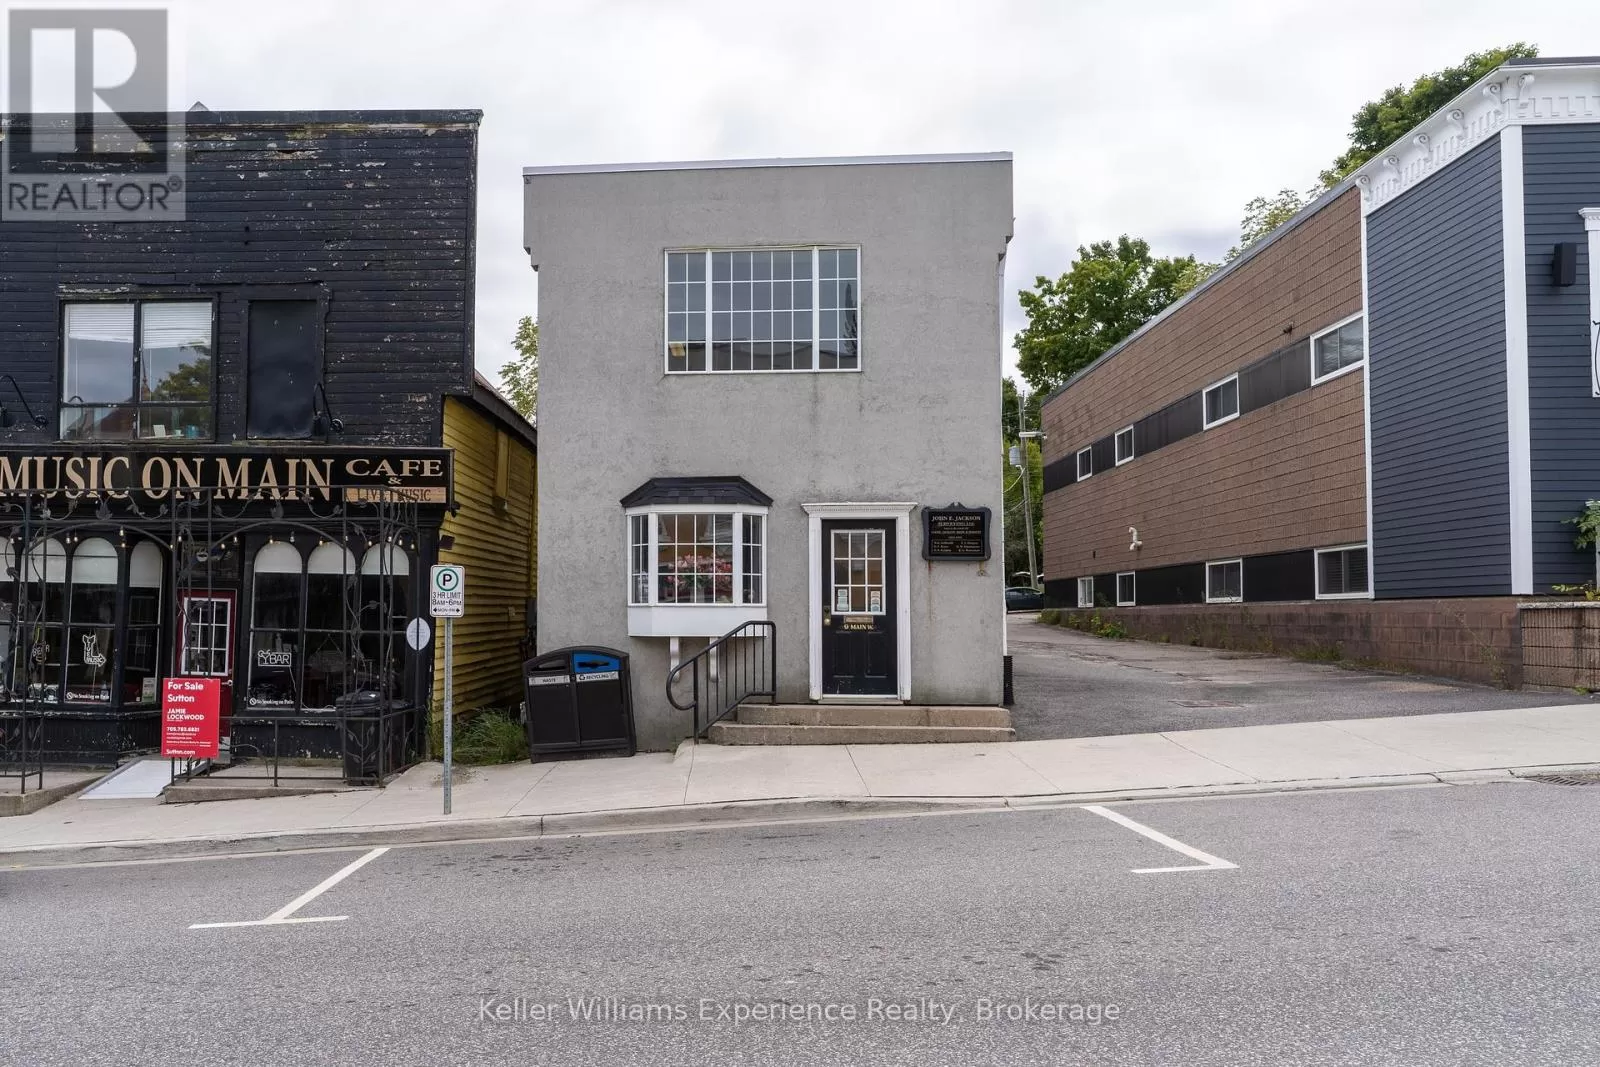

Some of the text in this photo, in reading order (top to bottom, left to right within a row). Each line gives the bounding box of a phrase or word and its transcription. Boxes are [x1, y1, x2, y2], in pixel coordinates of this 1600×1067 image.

[345, 459, 443, 476] CAFE
[0, 456, 335, 501] MUSIC ON MAIN
[443, 573, 452, 586] P
[432, 591, 461, 599] 3 HR LIMIT
[270, 654, 290, 664] BAR
[168, 682, 204, 690] For Sale
[167, 694, 195, 703] Sutton
